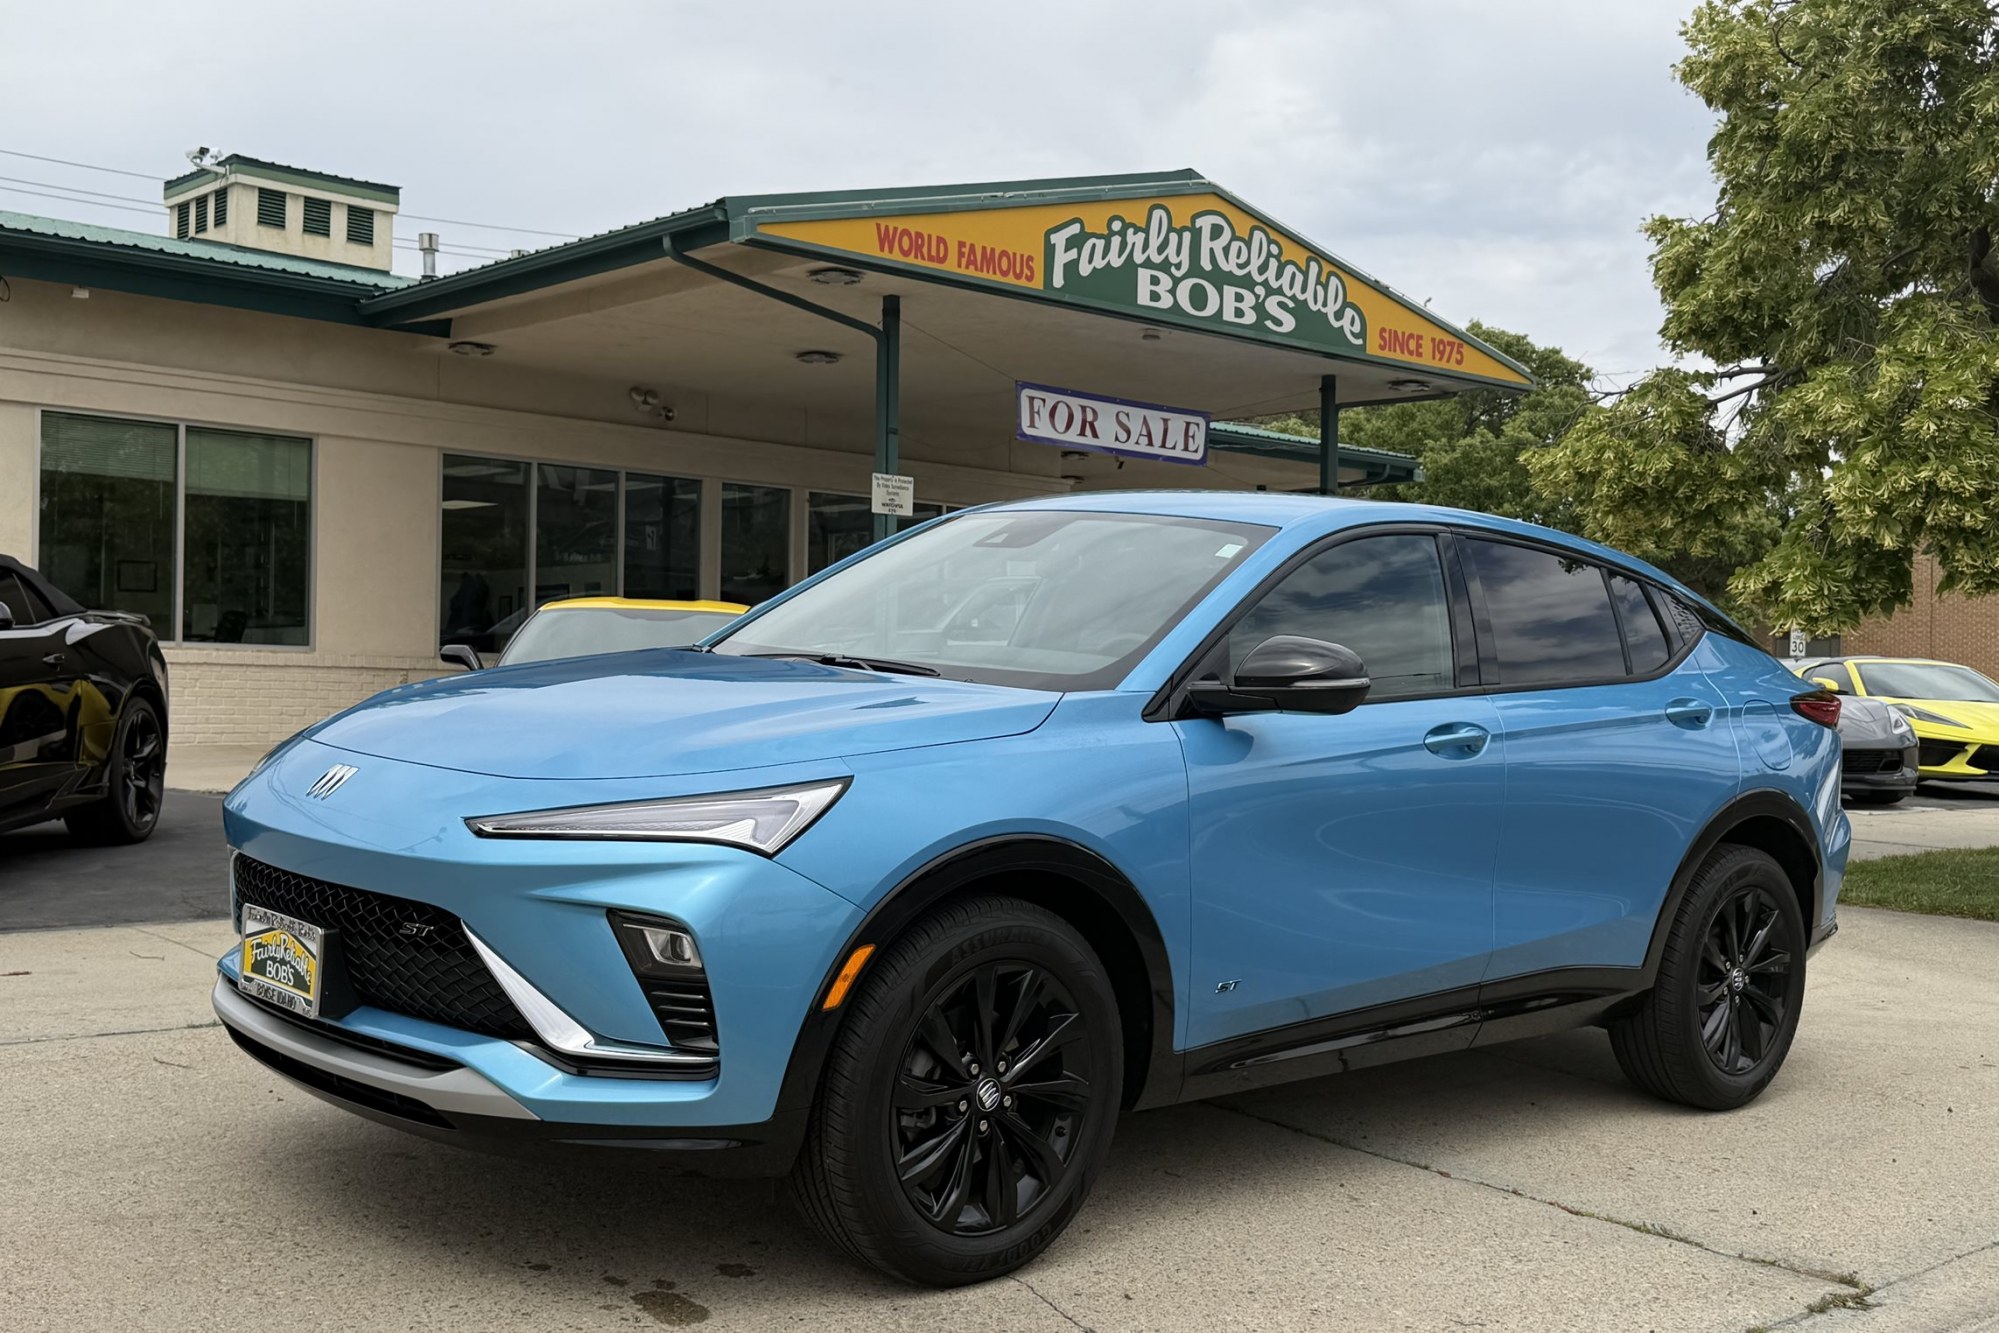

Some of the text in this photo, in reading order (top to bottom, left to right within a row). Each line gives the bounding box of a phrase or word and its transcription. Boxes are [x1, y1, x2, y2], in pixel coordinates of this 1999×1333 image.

[876, 222, 1035, 283] WORLD FAMOUS
[1050, 209, 1364, 345] Fairly Reliable
[1137, 267, 1297, 333] BOB'S
[1378, 327, 1465, 366] SINCE 1975
[1026, 395, 1201, 454] FOR SALE
[1792, 641, 1805, 653] 30
[399, 922, 434, 937] ST
[251, 932, 312, 985] Fairly Reliable
[266, 960, 295, 986] BOB'S
[1215, 979, 1242, 993] ST
